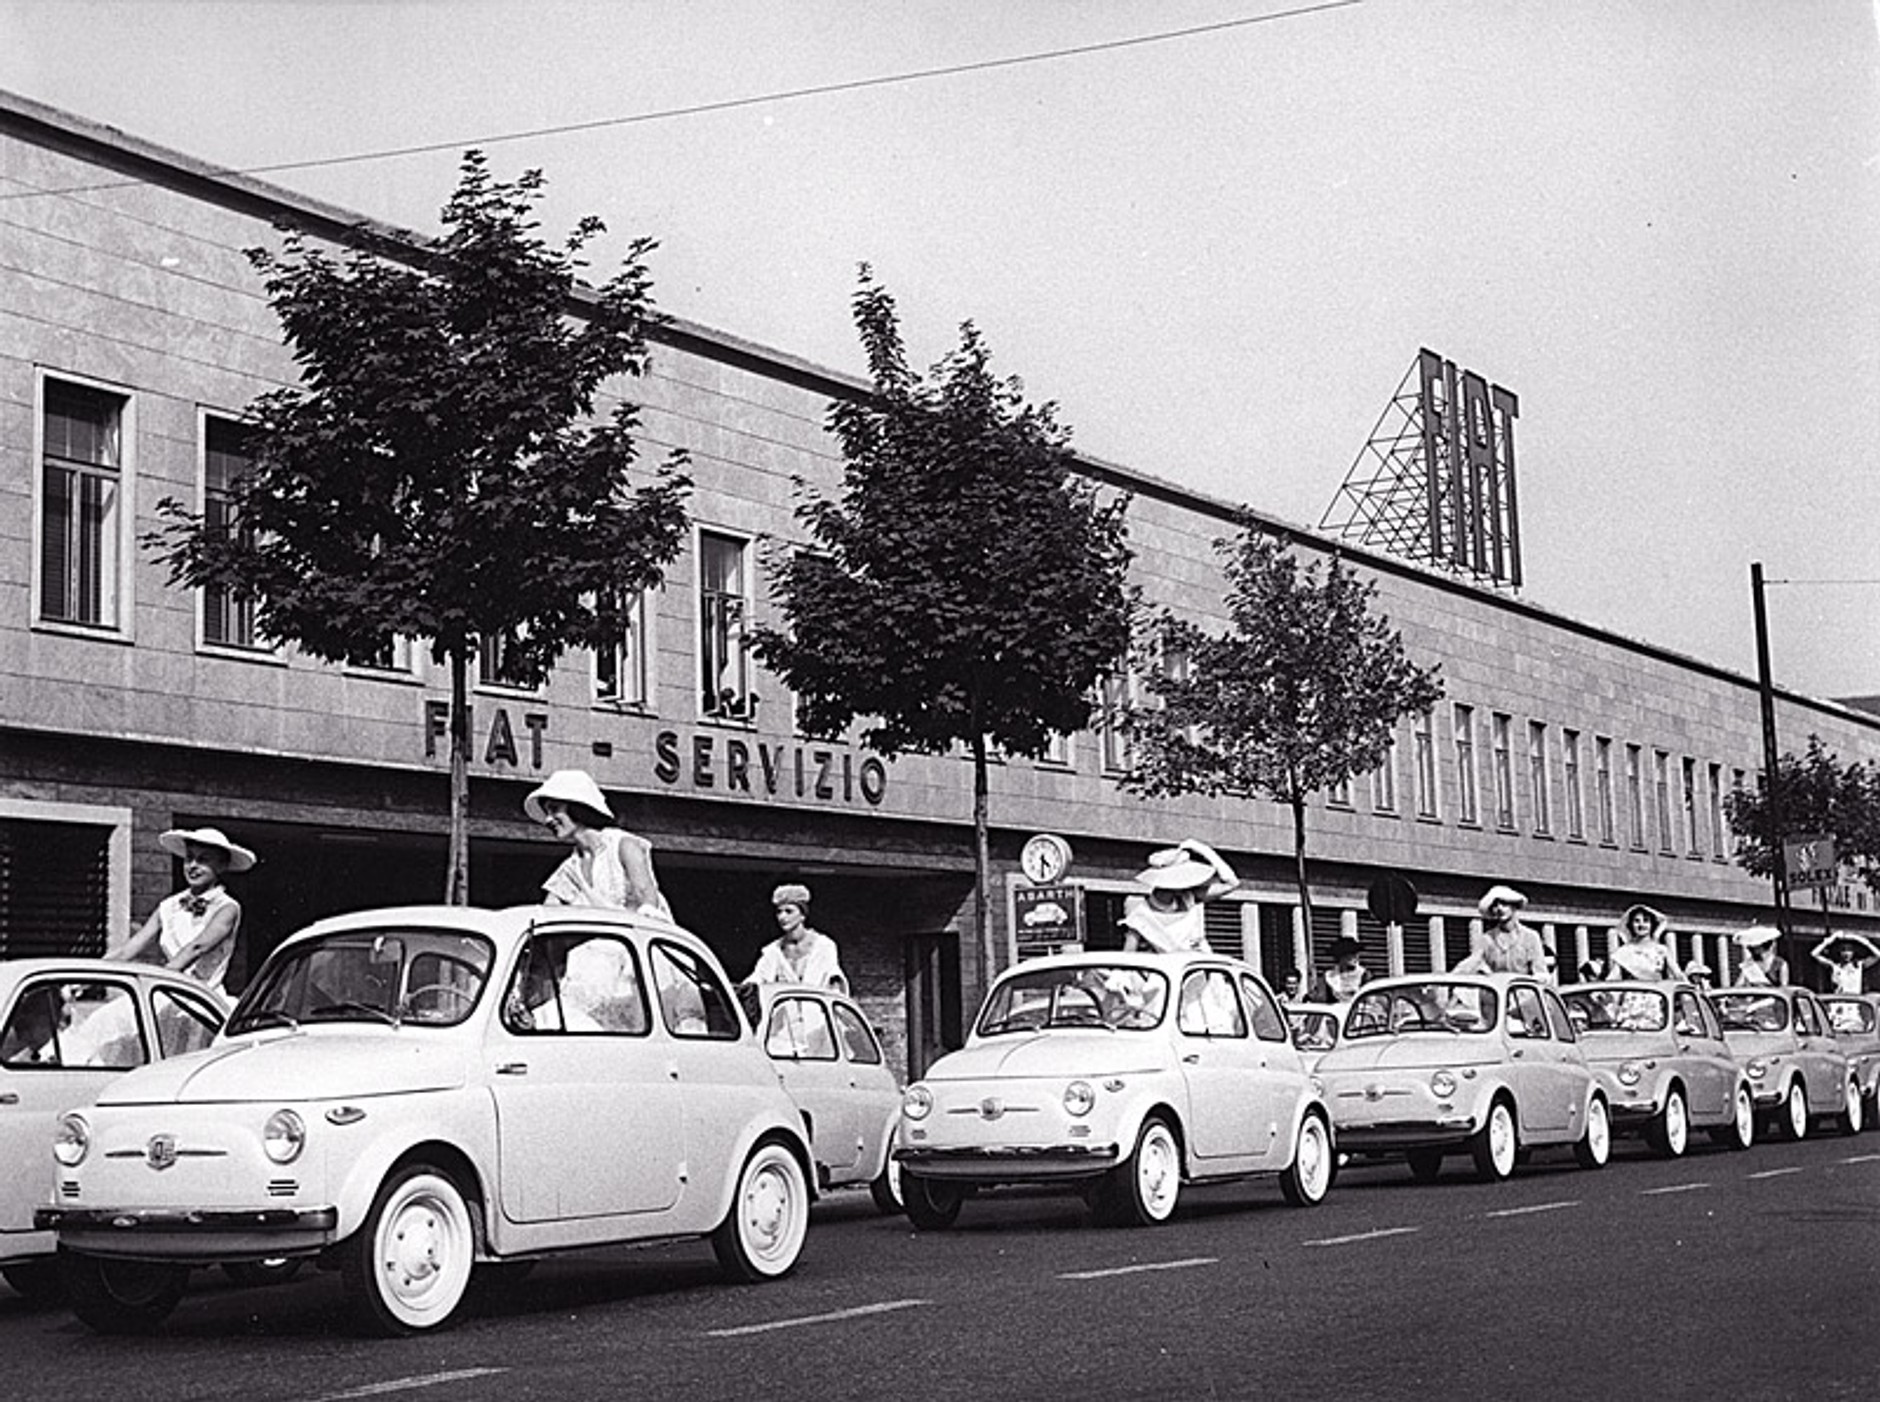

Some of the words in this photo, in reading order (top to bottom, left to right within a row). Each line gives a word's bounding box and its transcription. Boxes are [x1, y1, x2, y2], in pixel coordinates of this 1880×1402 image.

[1420, 347, 1521, 586] FIAT
[425, 700, 549, 769] FIAT
[654, 731, 887, 806] SERVIZIO
[1018, 890, 1073, 902] ABARTH
